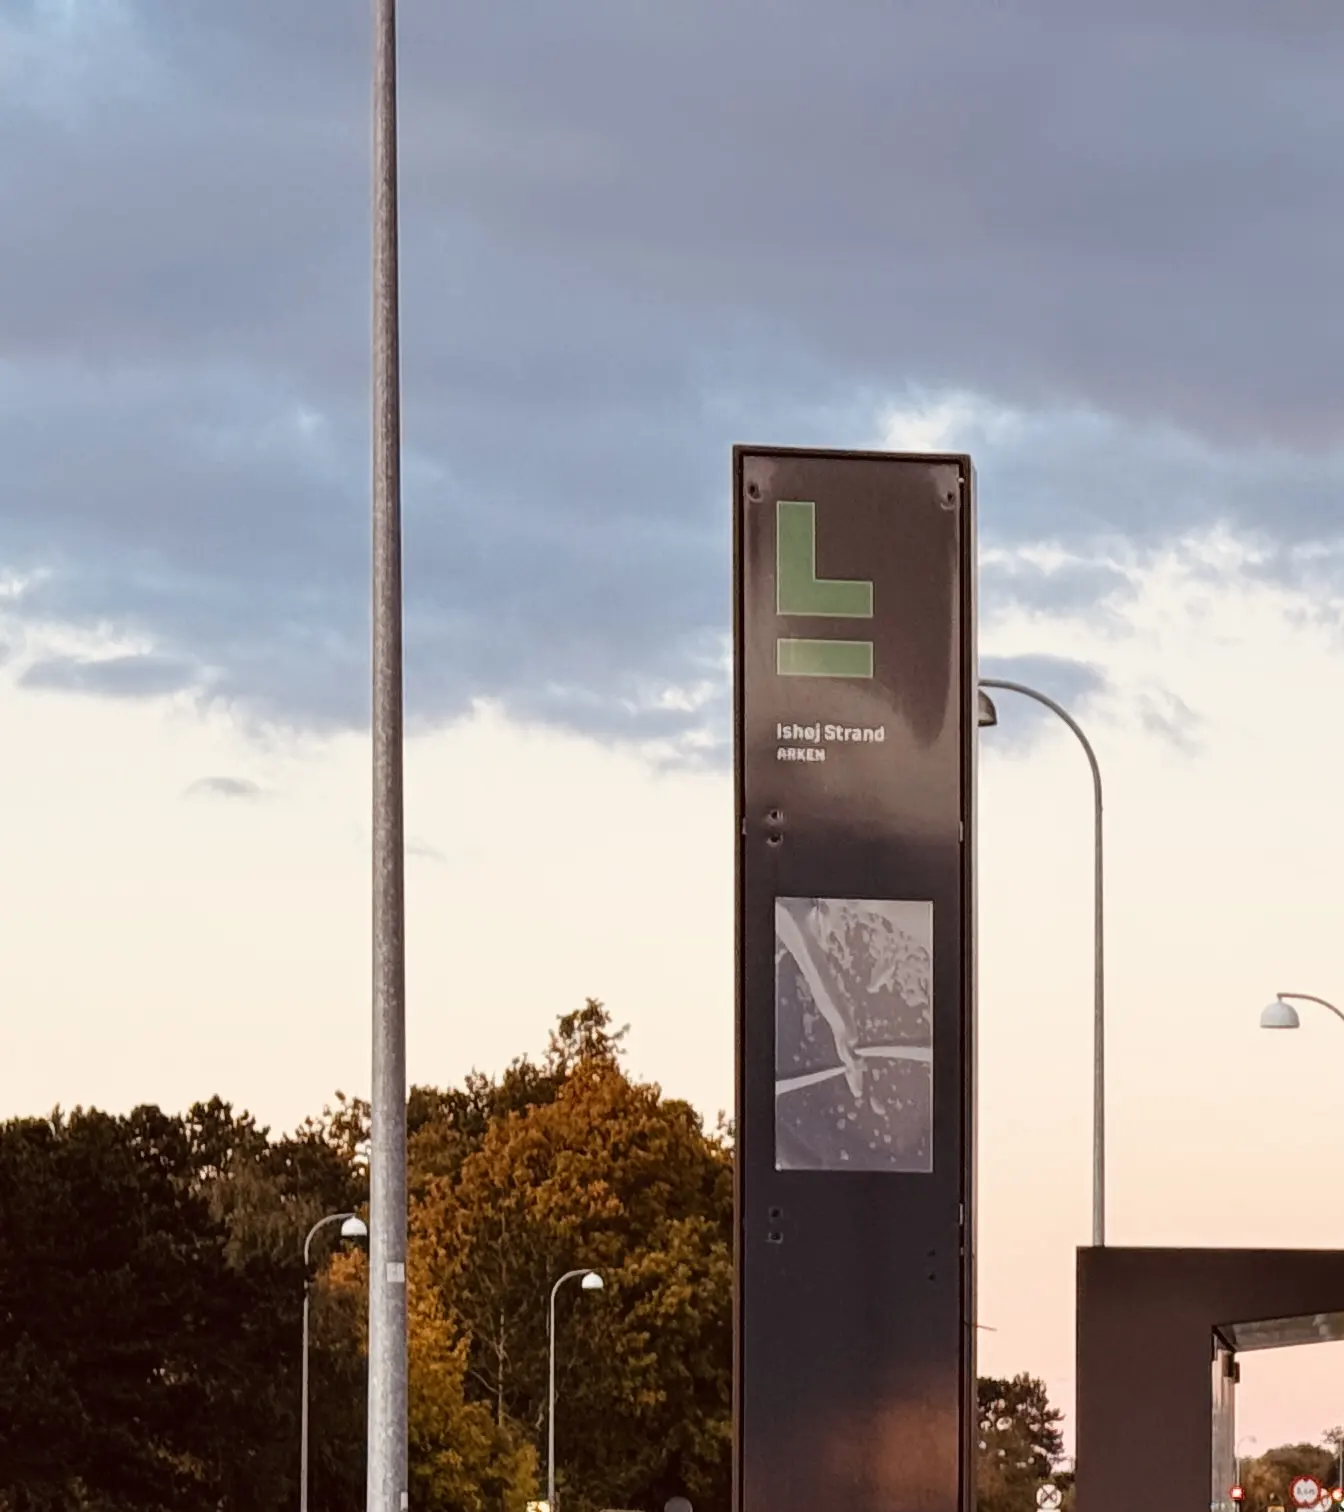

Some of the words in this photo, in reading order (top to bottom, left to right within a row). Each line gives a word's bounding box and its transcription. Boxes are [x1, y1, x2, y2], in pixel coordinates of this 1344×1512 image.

[777, 722, 820, 744] Ishøj
[824, 724, 885, 742] Strand
[777, 747, 826, 761] ARKEN
